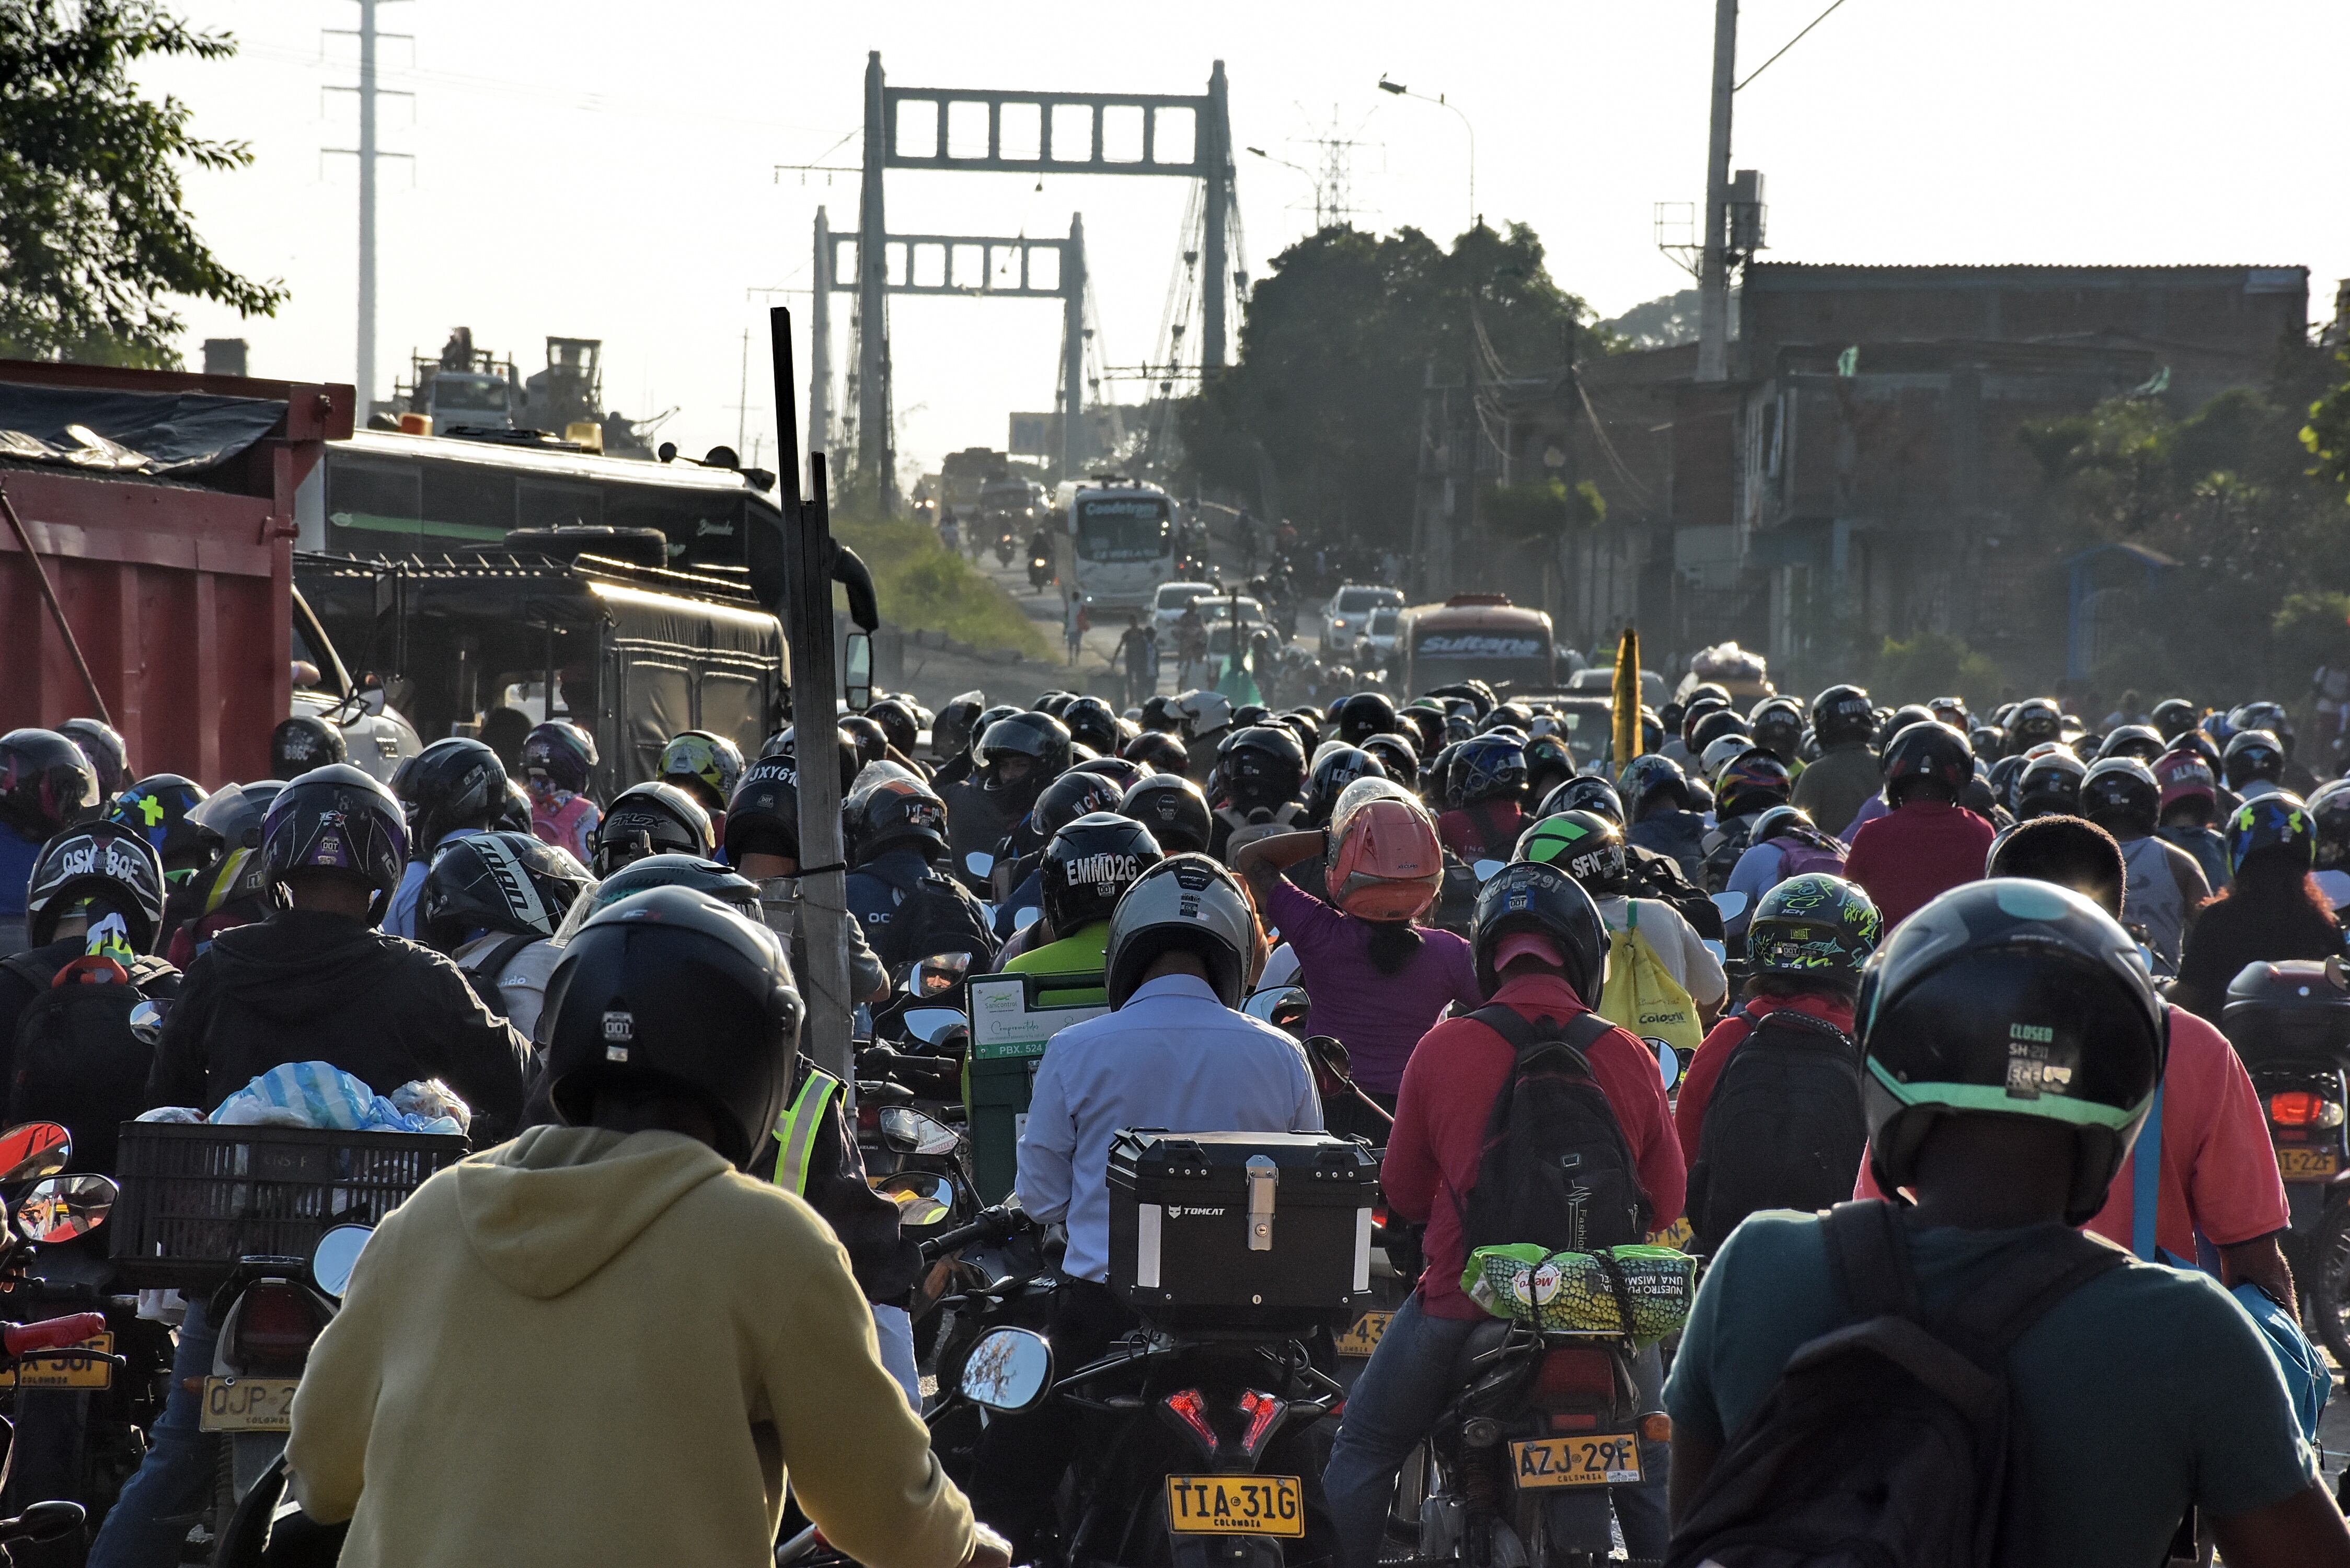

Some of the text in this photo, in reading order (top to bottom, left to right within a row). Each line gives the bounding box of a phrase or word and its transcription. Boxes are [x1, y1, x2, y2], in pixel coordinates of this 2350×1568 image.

[1419, 636, 1540, 656] Sultana
[323, 841, 339, 850] DOT
[1572, 850, 1602, 879] SFN
[2010, 1024, 2053, 1042] CLOSED
[999, 1043, 1042, 1055] PBX. 524
[1184, 1207, 1225, 1216] TOMCAT
[1519, 1277, 1554, 1288] Mero
[1661, 1276, 1683, 1285] UNA
[1644, 1286, 1683, 1296] NUESTRO
[1557, 1473, 1602, 1483] COLOMBIA
[1214, 1518, 1261, 1528] COLOMBIA
